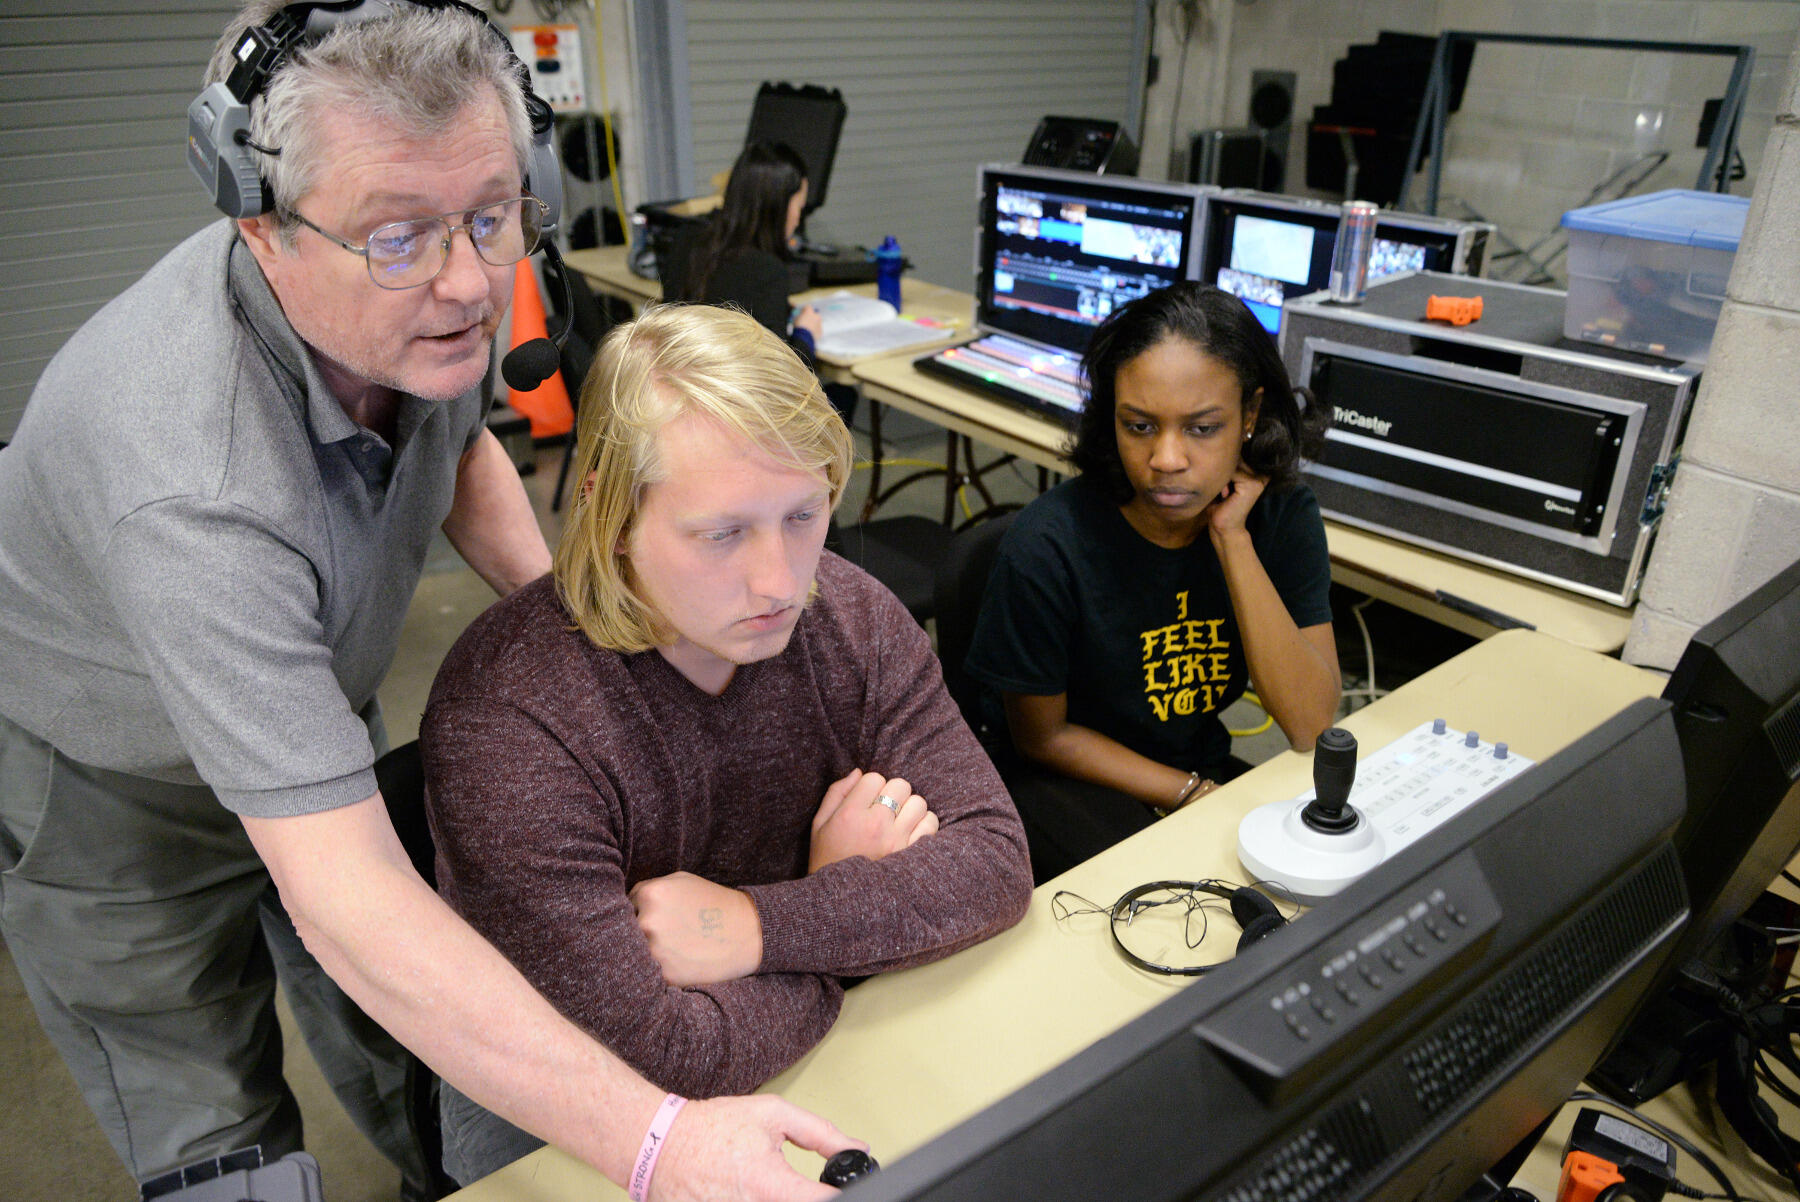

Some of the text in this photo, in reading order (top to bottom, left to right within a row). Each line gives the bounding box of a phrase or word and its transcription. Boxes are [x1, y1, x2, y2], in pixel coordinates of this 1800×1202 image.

[1333, 406, 1392, 436] TriCaster
[1176, 590, 1190, 620] I
[1139, 618, 1230, 661] FEEL
[1143, 653, 1232, 693] LIKE
[633, 1146, 654, 1190] STRONG
